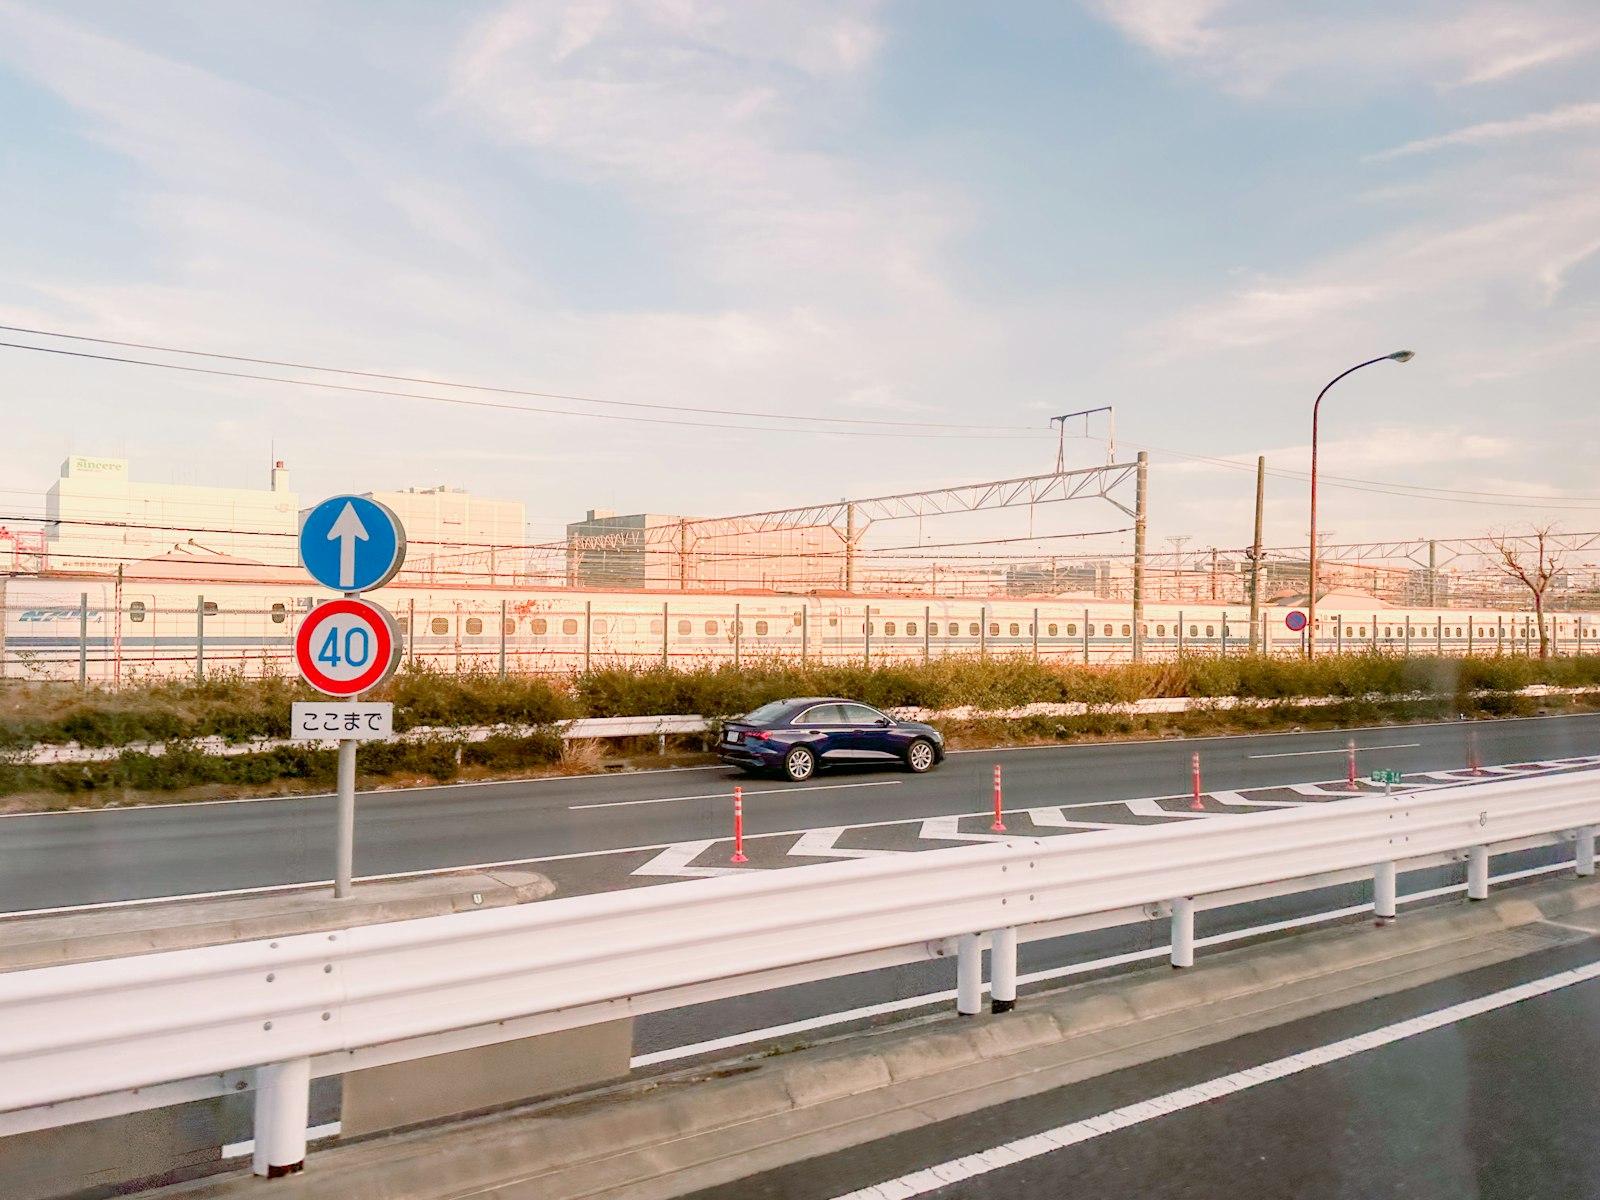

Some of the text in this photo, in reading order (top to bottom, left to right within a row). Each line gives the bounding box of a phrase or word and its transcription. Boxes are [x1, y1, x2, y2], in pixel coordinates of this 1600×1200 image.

[76, 459, 122, 471] sincere
[318, 627, 369, 667] 40
[303, 712, 382, 731] ここまで
